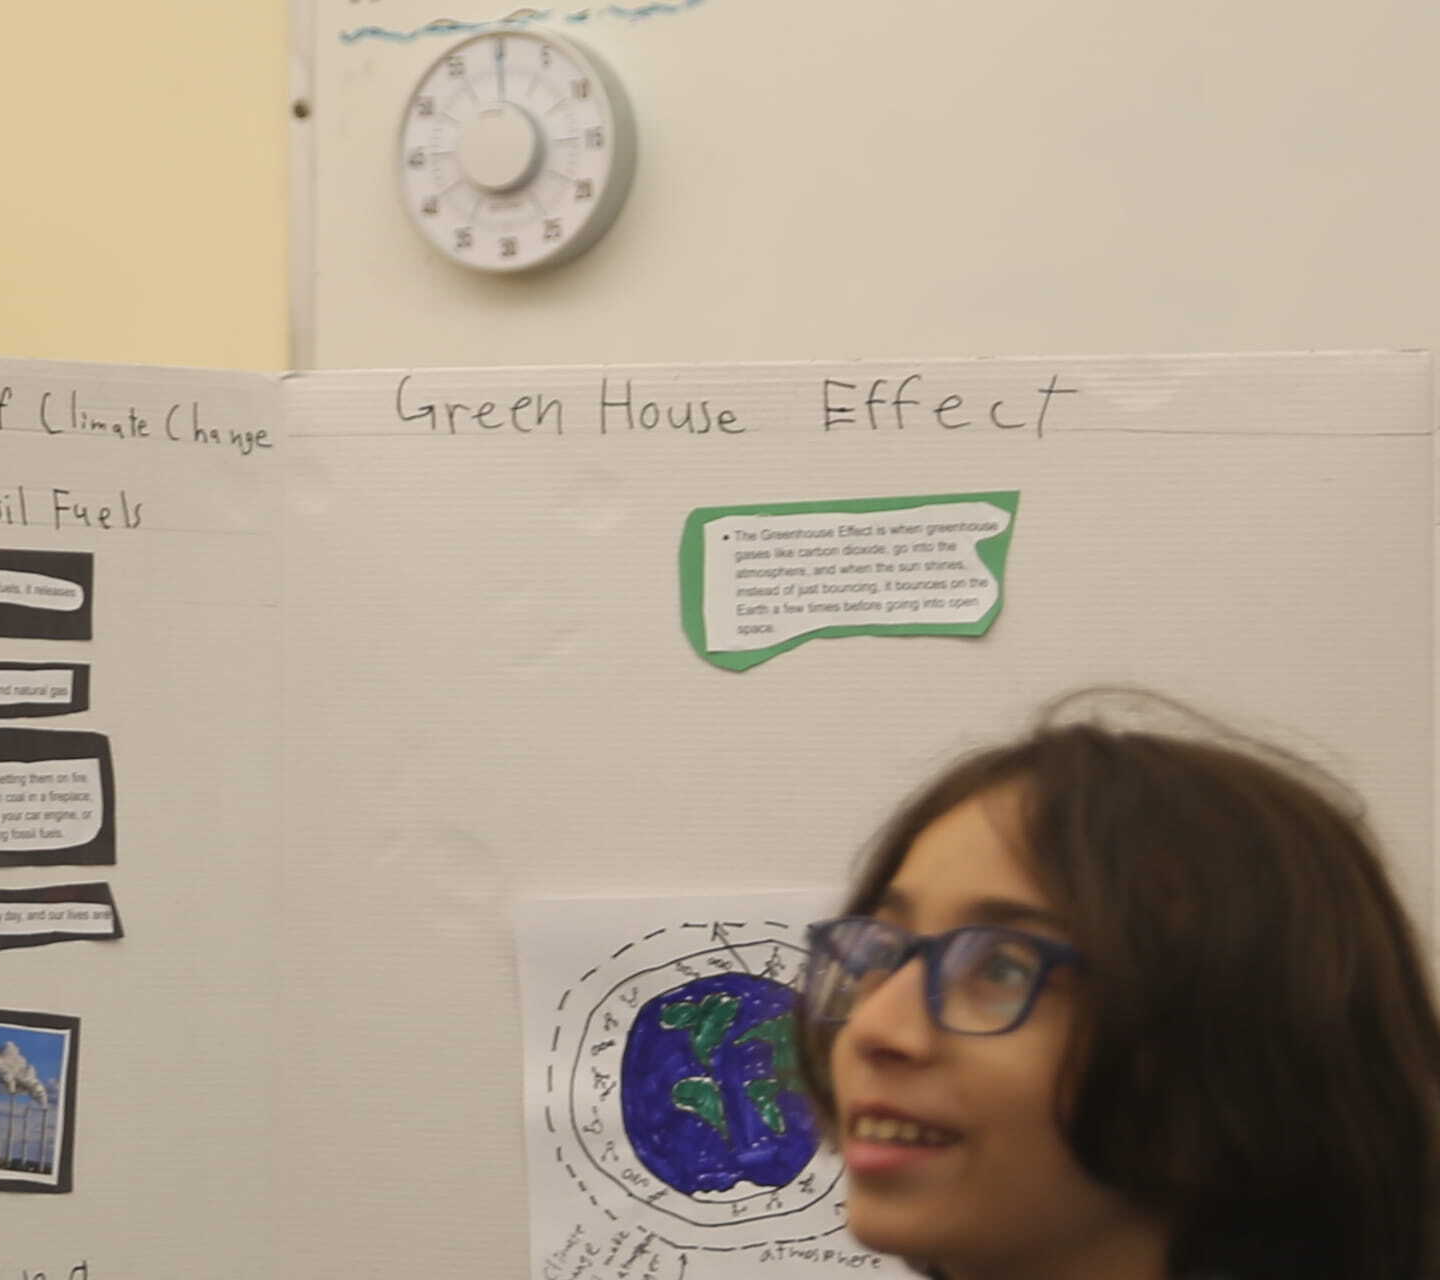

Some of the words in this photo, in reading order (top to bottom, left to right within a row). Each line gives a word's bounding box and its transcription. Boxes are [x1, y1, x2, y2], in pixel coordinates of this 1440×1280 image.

[396, 374, 565, 435] Green
[599, 377, 746, 435] House
[820, 374, 1079, 438] Effect
[40, 391, 150, 437] Climate
[166, 402, 273, 454] Change
[53, 488, 142, 530] Fuels
[735, 530, 756, 541] The
[760, 529, 835, 541] Greenhouse
[838, 525, 872, 537] Effect
[877, 526, 887, 536] is
[890, 525, 923, 534] when
[927, 523, 998, 536] greenhouse
[735, 550, 770, 562] gases
[775, 548, 794, 558] like
[798, 546, 838, 557] carbon
[893, 544, 909, 555] go
[912, 542, 934, 552] into
[938, 541, 957, 551] the
[814, 566, 836, 575] and
[840, 564, 873, 573] when
[876, 563, 895, 573] the
[898, 562, 921, 571] sun
[737, 586, 780, 597] instead
[783, 585, 794, 595] of
[798, 584, 819, 597] just
[886, 581, 892, 591] it
[895, 580, 947, 590] bounces
[951, 579, 966, 588] on
[969, 578, 988, 588] the
[737, 603, 768, 615] Earth
[773, 605, 780, 614] a
[783, 602, 803, 613] few
[808, 601, 840, 613] times
[843, 600, 882, 611] before
[885, 600, 920, 612] going
[924, 598, 945, 608] into
[949, 598, 979, 609] open
